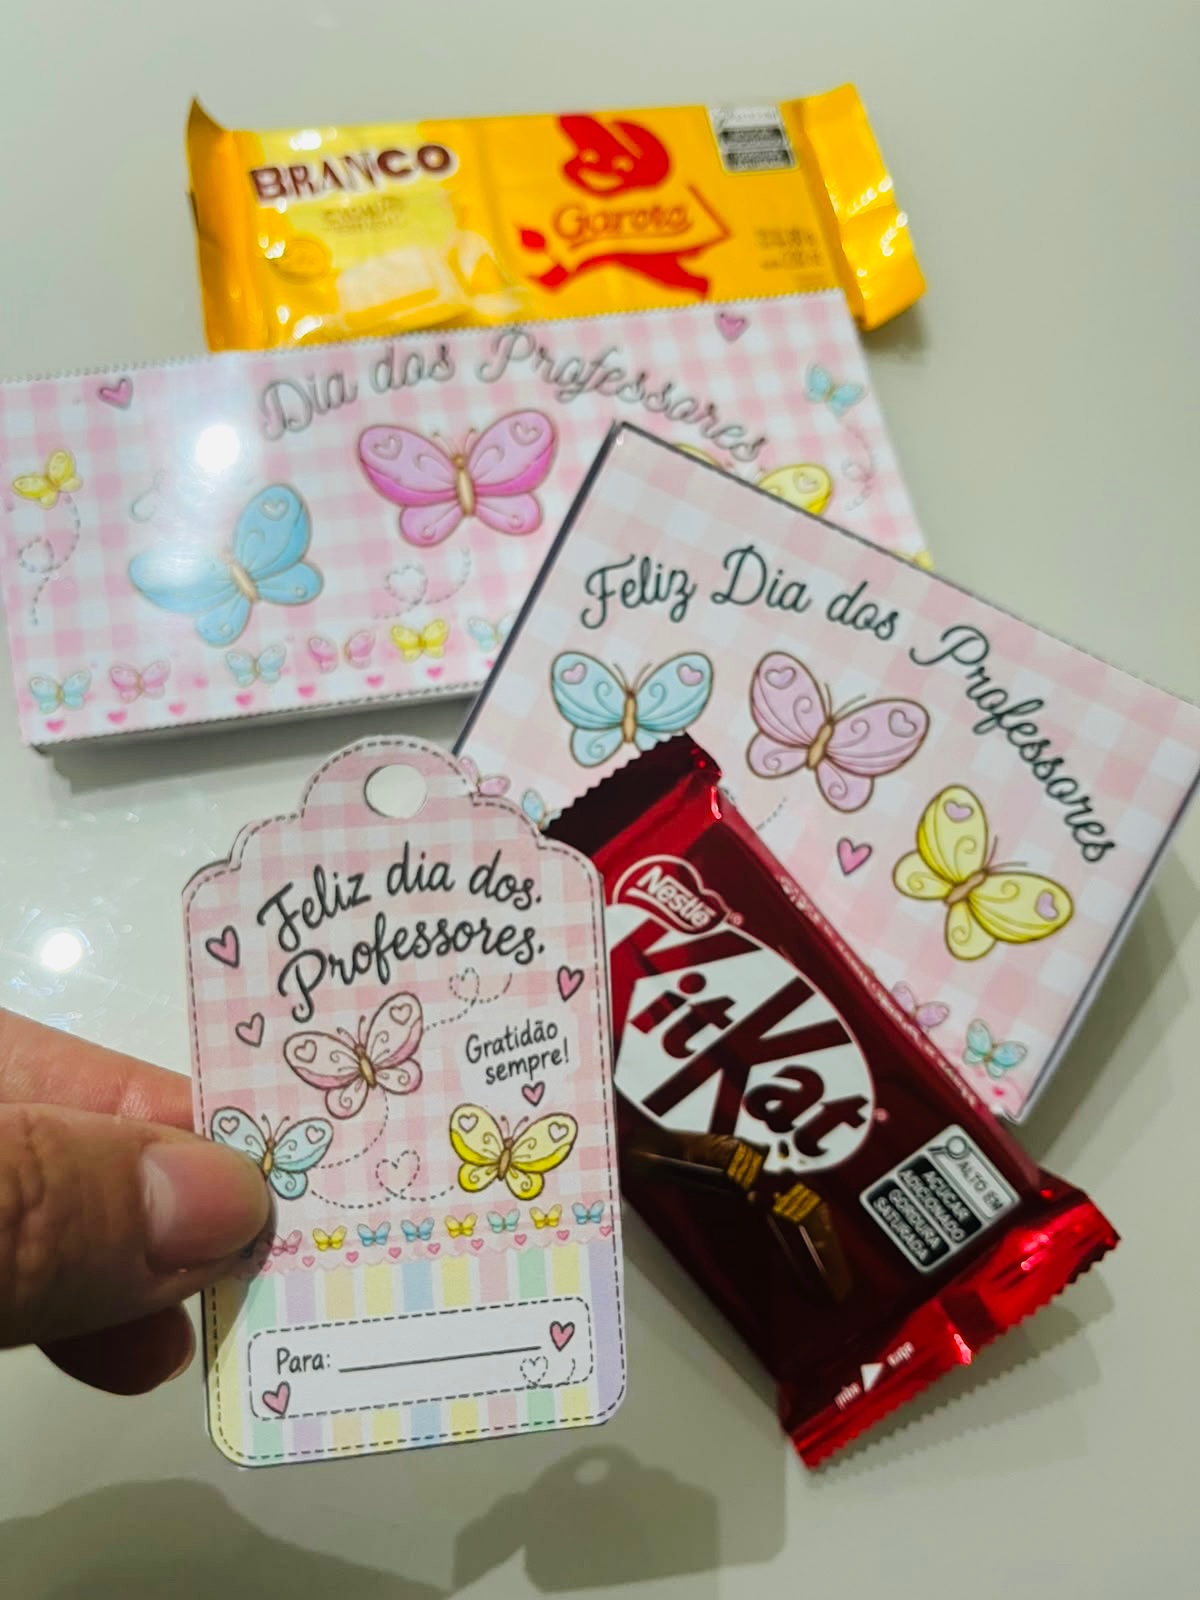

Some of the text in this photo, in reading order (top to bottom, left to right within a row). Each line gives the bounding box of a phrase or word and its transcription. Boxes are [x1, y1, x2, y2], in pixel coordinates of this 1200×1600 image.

[250, 144, 454, 203] BRANCO
[260, 328, 768, 463] Dia dos Professores
[580, 544, 1119, 864] Feliz Dia dos Professores
[256, 863, 372, 953] Feliz
[386, 840, 456, 897] dia
[636, 864, 716, 928] Nestlé
[464, 1019, 559, 1065] Gratidão
[485, 1037, 570, 1086] sempre!
[958, 1160, 987, 1193] ALTO
[276, 1347, 331, 1375] Para:
